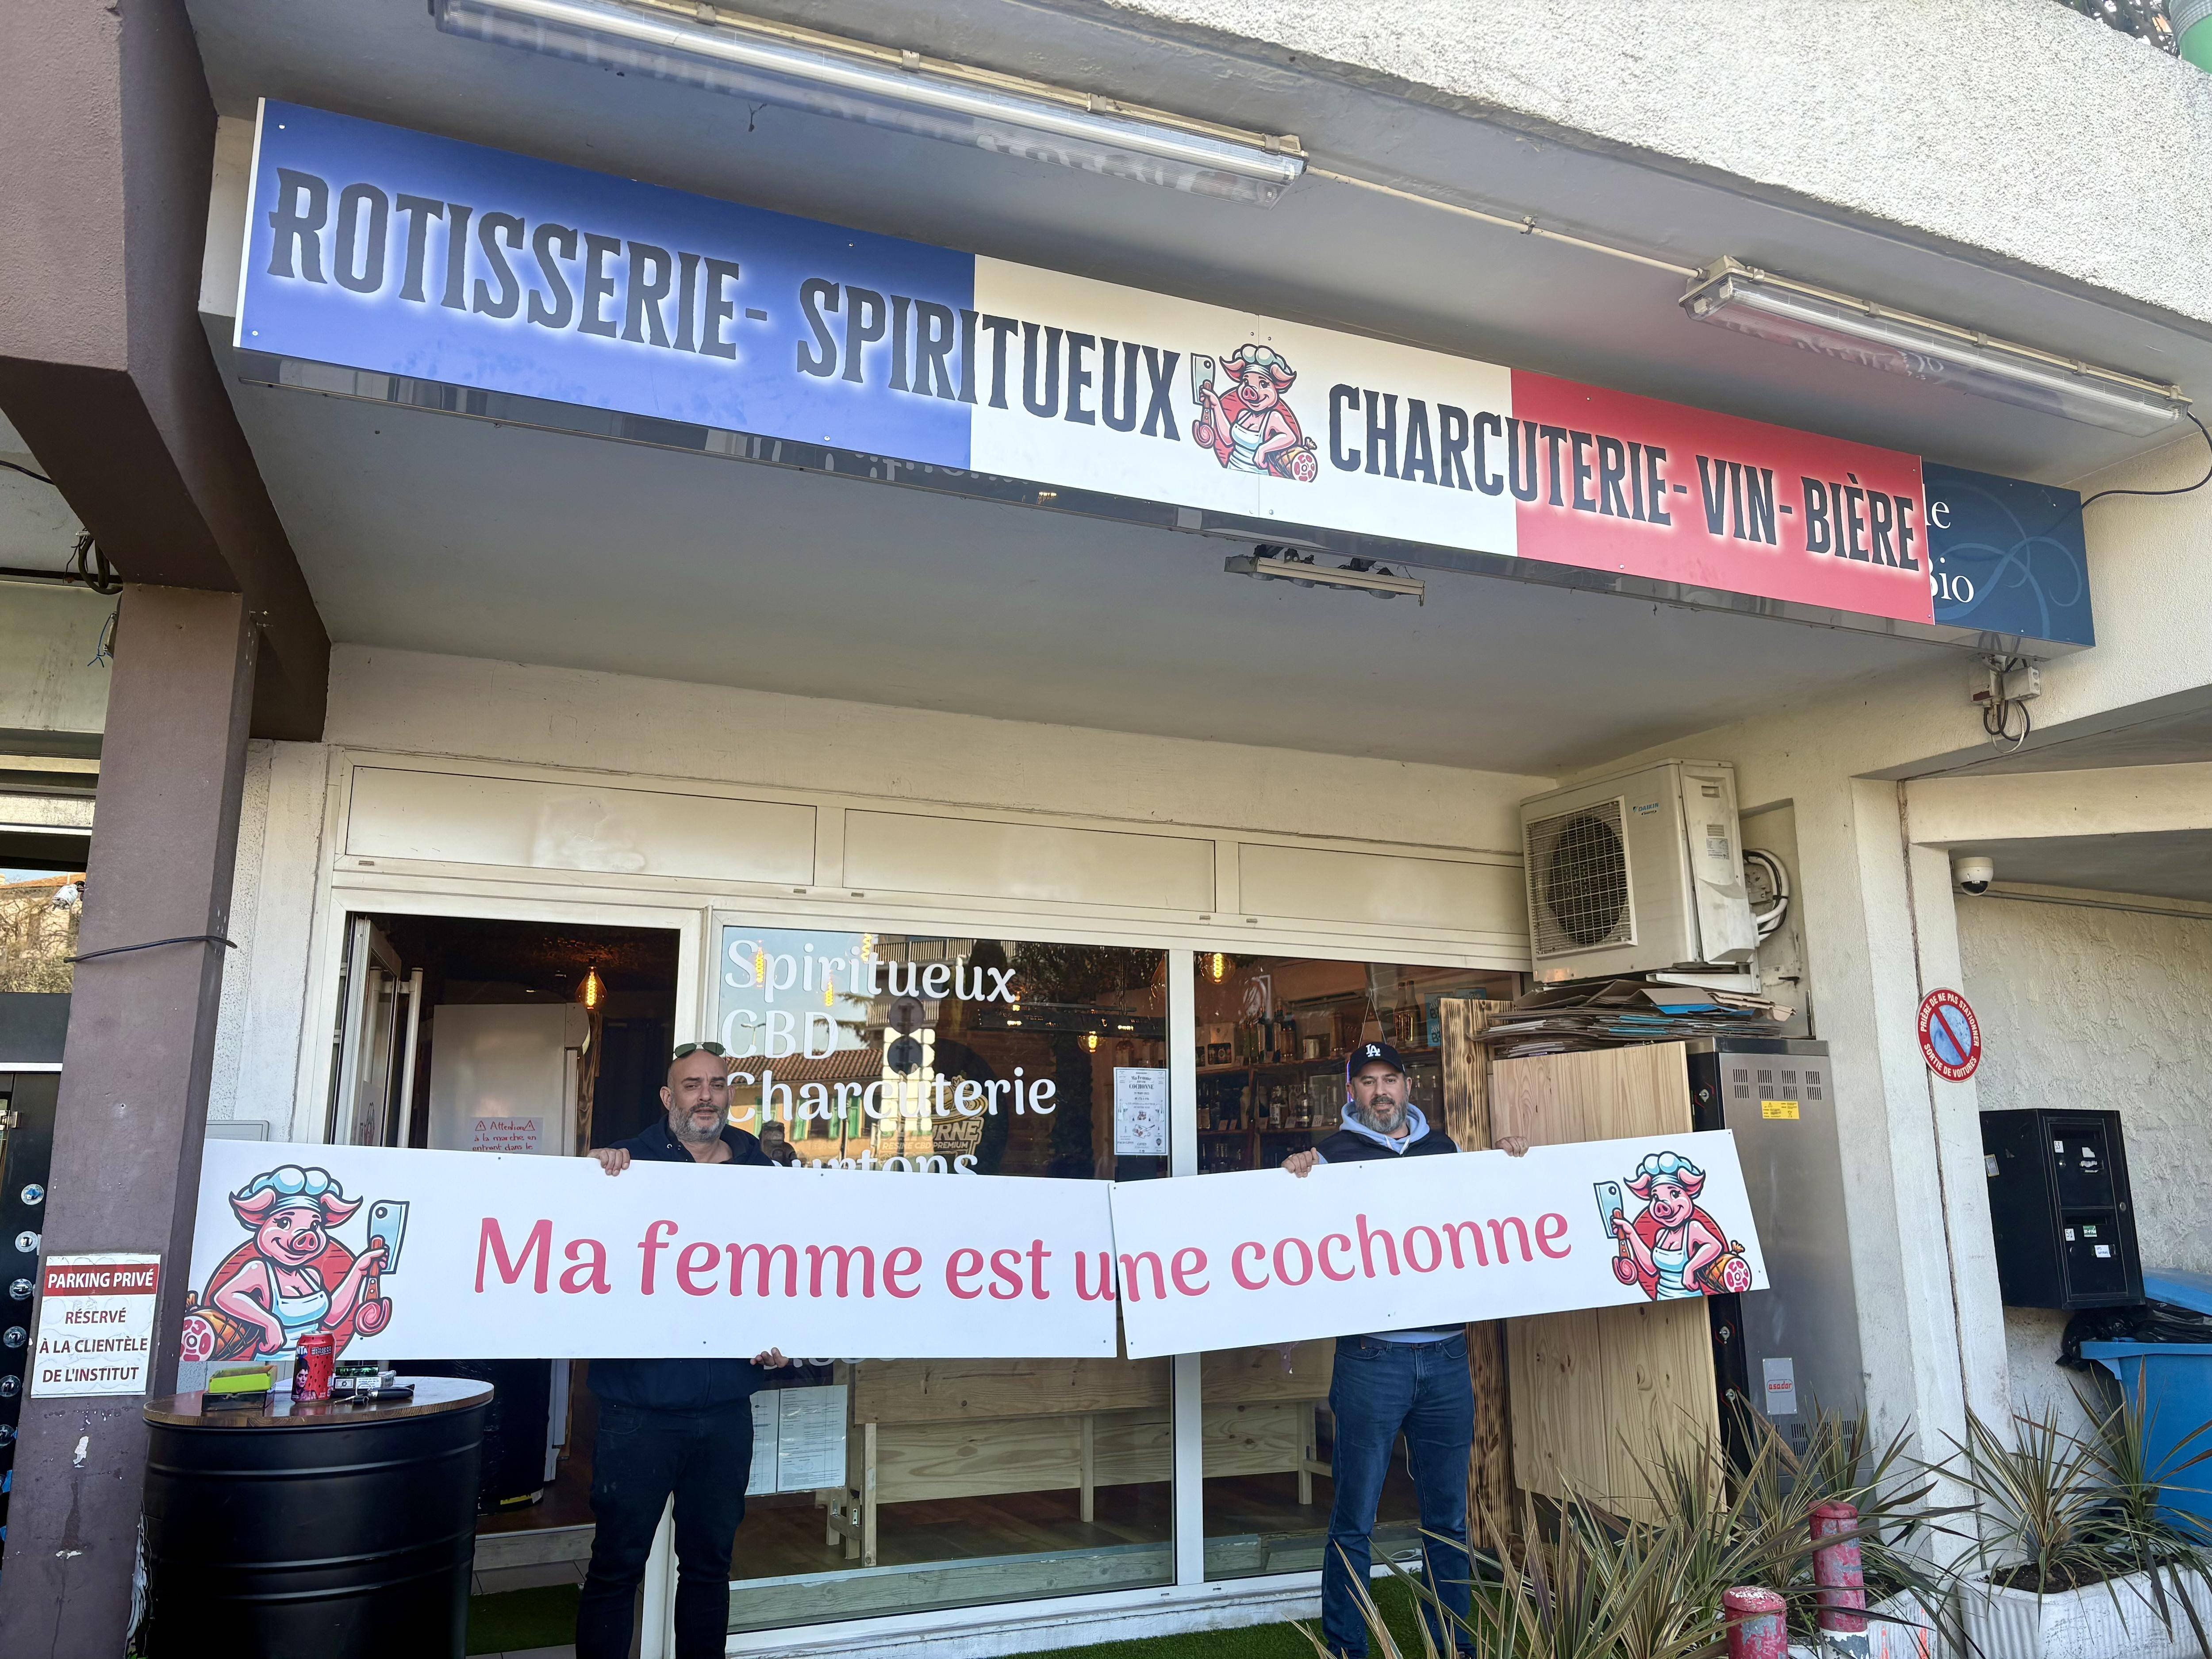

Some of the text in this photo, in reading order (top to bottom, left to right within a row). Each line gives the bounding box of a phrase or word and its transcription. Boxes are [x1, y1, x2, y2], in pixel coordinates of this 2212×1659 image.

[797, 277, 1181, 442] SPIRITUEUX
[1639, 802, 1659, 811] DAIKIN
[725, 940, 1017, 1003] Spiritueux
[1920, 992, 1979, 1047] PRIÈRE DE NE PAS STATIONNER
[721, 1009, 838, 1060] CBD
[1366, 1044, 1381, 1057] LA
[1924, 1043, 1977, 1078] SORTIE DE VOITURES
[727, 1067, 1056, 1123] Charcuterie
[490, 1121, 525, 1131] Attention
[475, 1213, 1571, 1302] Ma femme est une cochonne
[48, 1268, 154, 1289] PARKING PRIVÉ
[65, 1307, 127, 1324] RÉSERVÉ
[39, 1335, 147, 1354] À LA CLIENTÈLE
[43, 1367, 139, 1382] DE L'INSTITUT
[1769, 1381, 1792, 1390] asador
